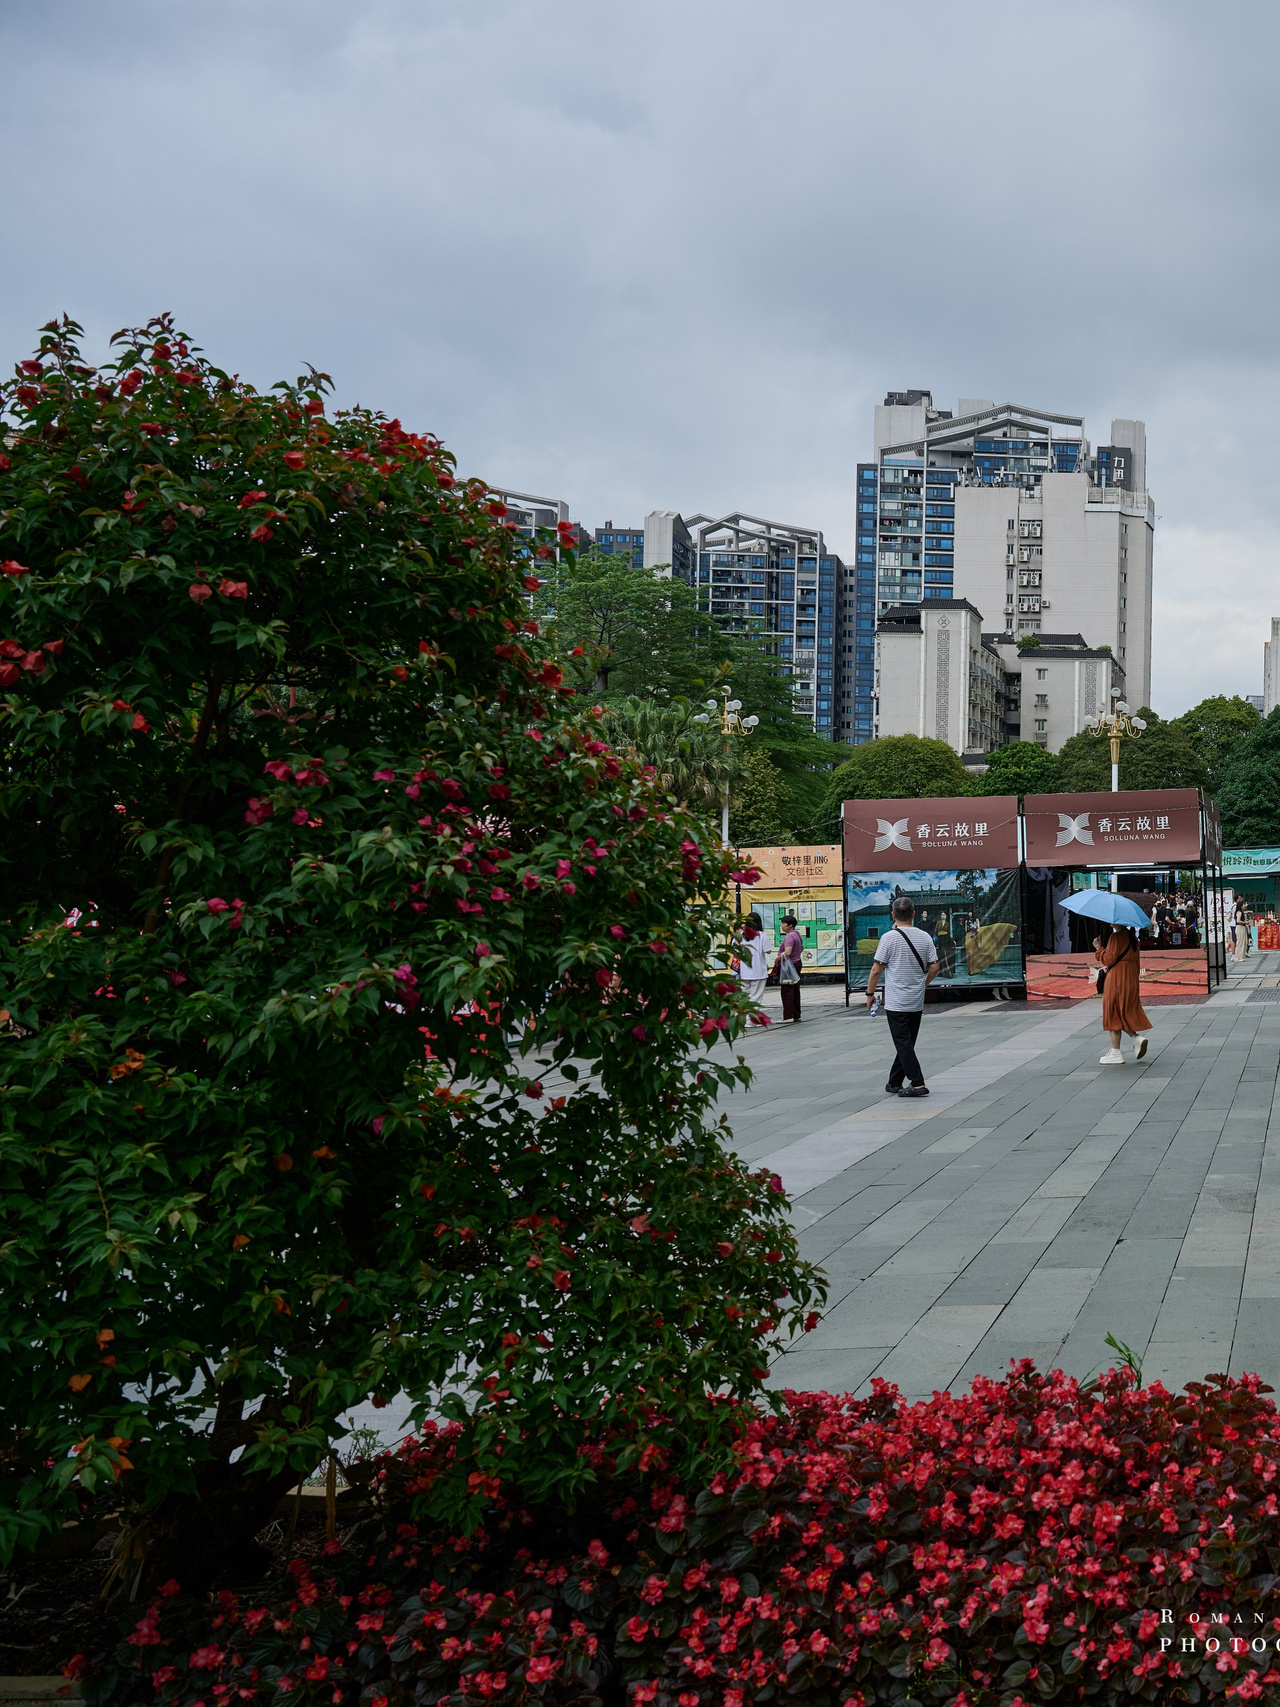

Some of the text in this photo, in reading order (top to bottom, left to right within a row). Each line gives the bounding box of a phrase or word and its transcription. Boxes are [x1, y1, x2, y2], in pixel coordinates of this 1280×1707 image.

[1097, 815, 1171, 833] 香云故里
[915, 822, 989, 839] 香云故里
[961, 839, 984, 847] WANG
[1103, 834, 1140, 842] SOLLUNA
[786, 866, 824, 877] 文创社区
